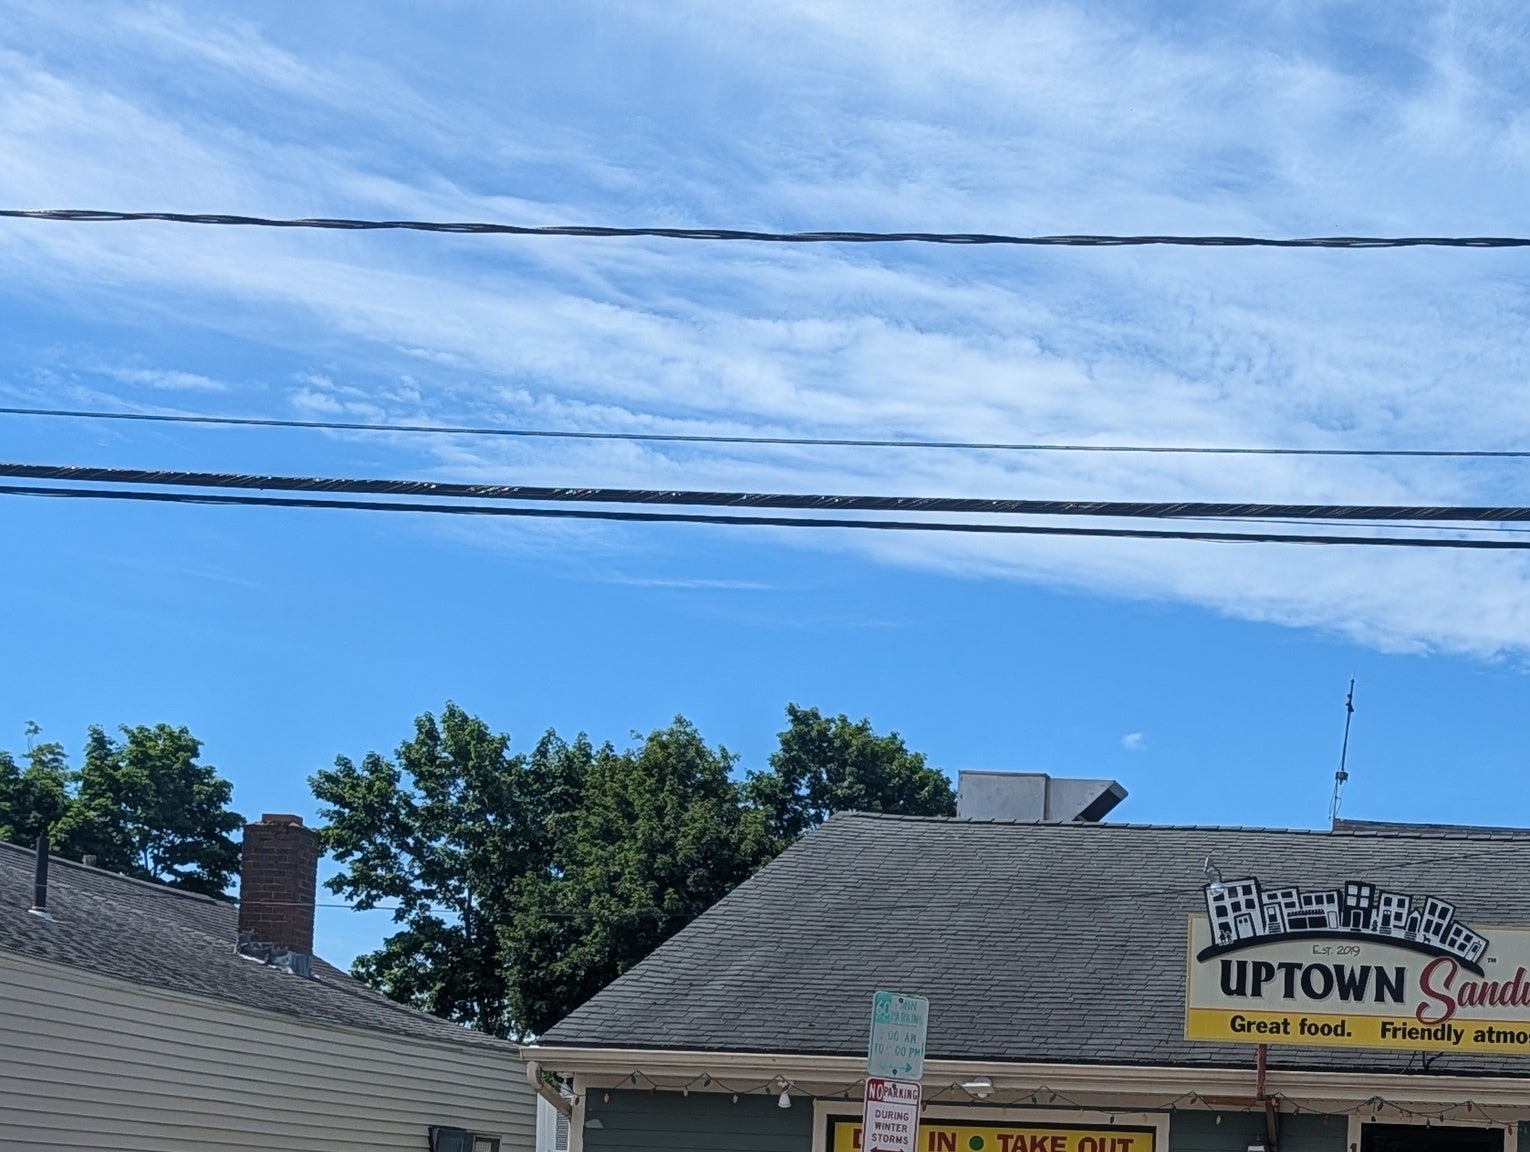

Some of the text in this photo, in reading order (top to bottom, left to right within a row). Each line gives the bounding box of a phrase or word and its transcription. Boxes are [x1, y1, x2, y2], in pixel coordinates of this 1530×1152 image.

[1336, 945, 1361, 957] 2019
[1220, 959, 1406, 1003] UPTOWN
[876, 1000, 891, 1016] 60
[1230, 1015, 1291, 1036] Great
[1299, 1016, 1352, 1038] food.
[1380, 1021, 1464, 1046] Friendly
[868, 1083, 918, 1100] NO PARKING
[875, 1109, 909, 1121] DURING
[874, 1121, 908, 1133] WINTER
[871, 1133, 909, 1145] STORMS
[928, 1131, 956, 1152] IN
